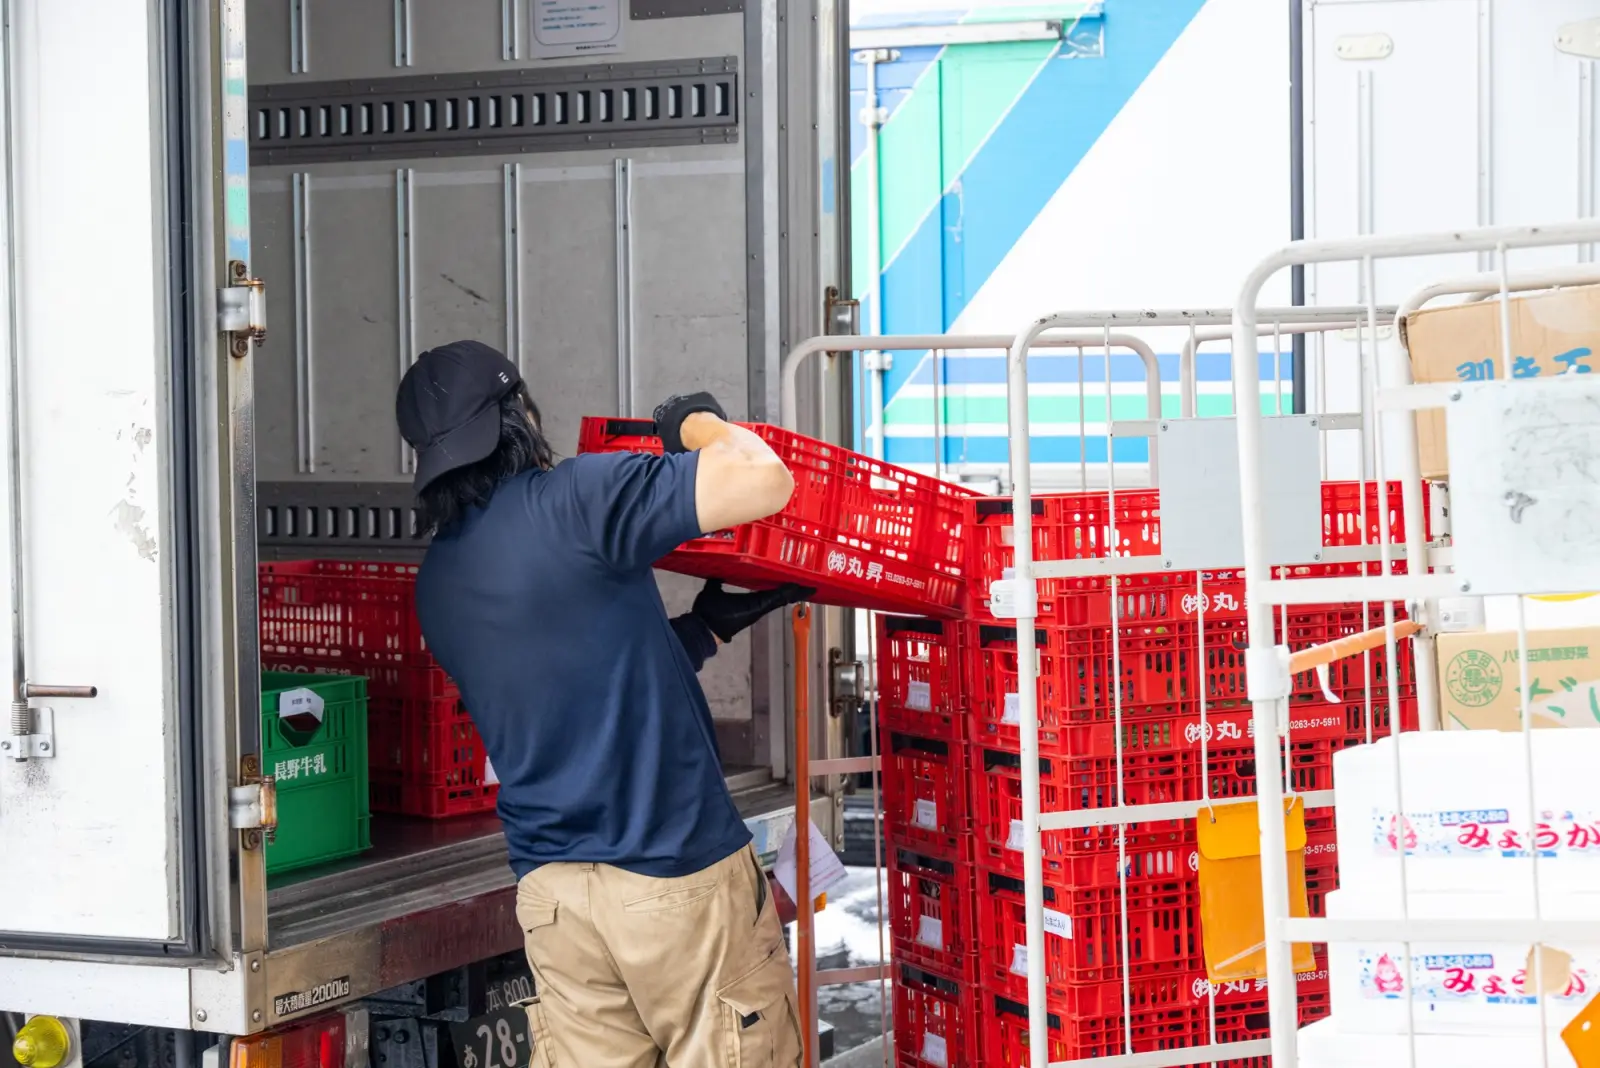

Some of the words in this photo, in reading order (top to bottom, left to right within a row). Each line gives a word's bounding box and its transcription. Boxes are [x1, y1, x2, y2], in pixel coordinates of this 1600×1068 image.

[1181, 592, 1248, 615] (株)丸
[275, 753, 327, 782] 長野牛乳
[485, 986, 504, 1014] 本
[503, 976, 531, 1005] 800
[476, 1018, 535, 1068] 28-
